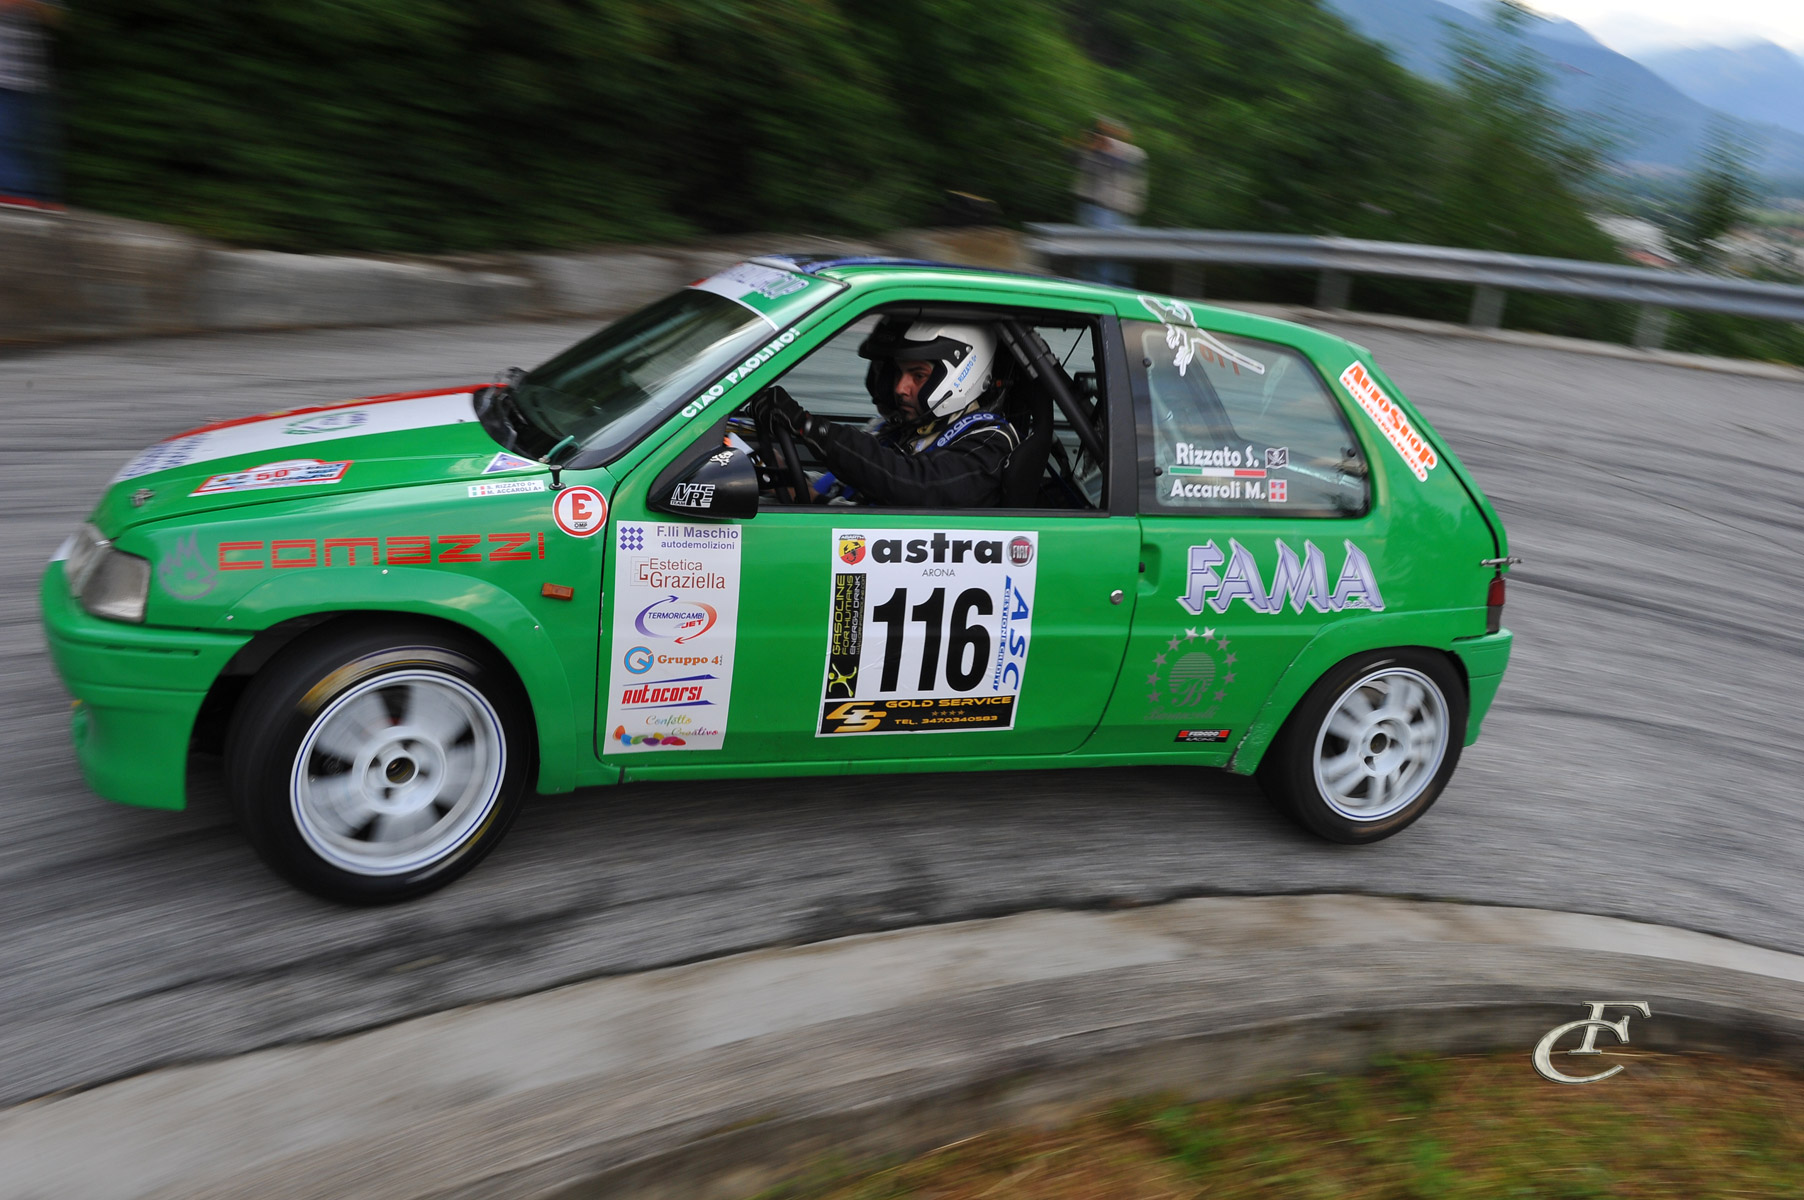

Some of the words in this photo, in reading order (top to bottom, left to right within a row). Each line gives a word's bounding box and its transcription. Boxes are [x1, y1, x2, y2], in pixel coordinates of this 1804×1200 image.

[957, 360, 974, 383] RIZZATO
[681, 384, 724, 418] CIAO
[1175, 442, 1241, 468] Rizzato
[1245, 445, 1260, 468] S.
[496, 486, 532, 494] ACCAROLI
[1170, 479, 1241, 501] Accaroli
[1244, 481, 1266, 501] M.
[572, 493, 593, 521] E
[683, 526, 739, 539] Maschio
[660, 540, 735, 551] autodemolizioni
[871, 532, 1003, 564] astra
[1012, 545, 1029, 559] FIAT
[650, 557, 703, 571] Estetica
[921, 568, 956, 577] ARONA
[650, 572, 726, 589] Graziella
[1176, 537, 1386, 616] FAMA
[844, 575, 854, 629] HUMANS
[853, 575, 861, 609] DRINK
[648, 611, 705, 621] TERMORICAMBI
[681, 619, 704, 629] JET
[832, 575, 846, 655] GASOLINE
[842, 631, 850, 655] FOR
[849, 610, 859, 655] ENERGY
[872, 587, 993, 692] 116
[1003, 587, 1029, 690] ASC
[657, 655, 709, 666] Gruppo
[711, 655, 719, 666] 4
[885, 699, 934, 709] GOLD
[938, 697, 1012, 708] SERVICE
